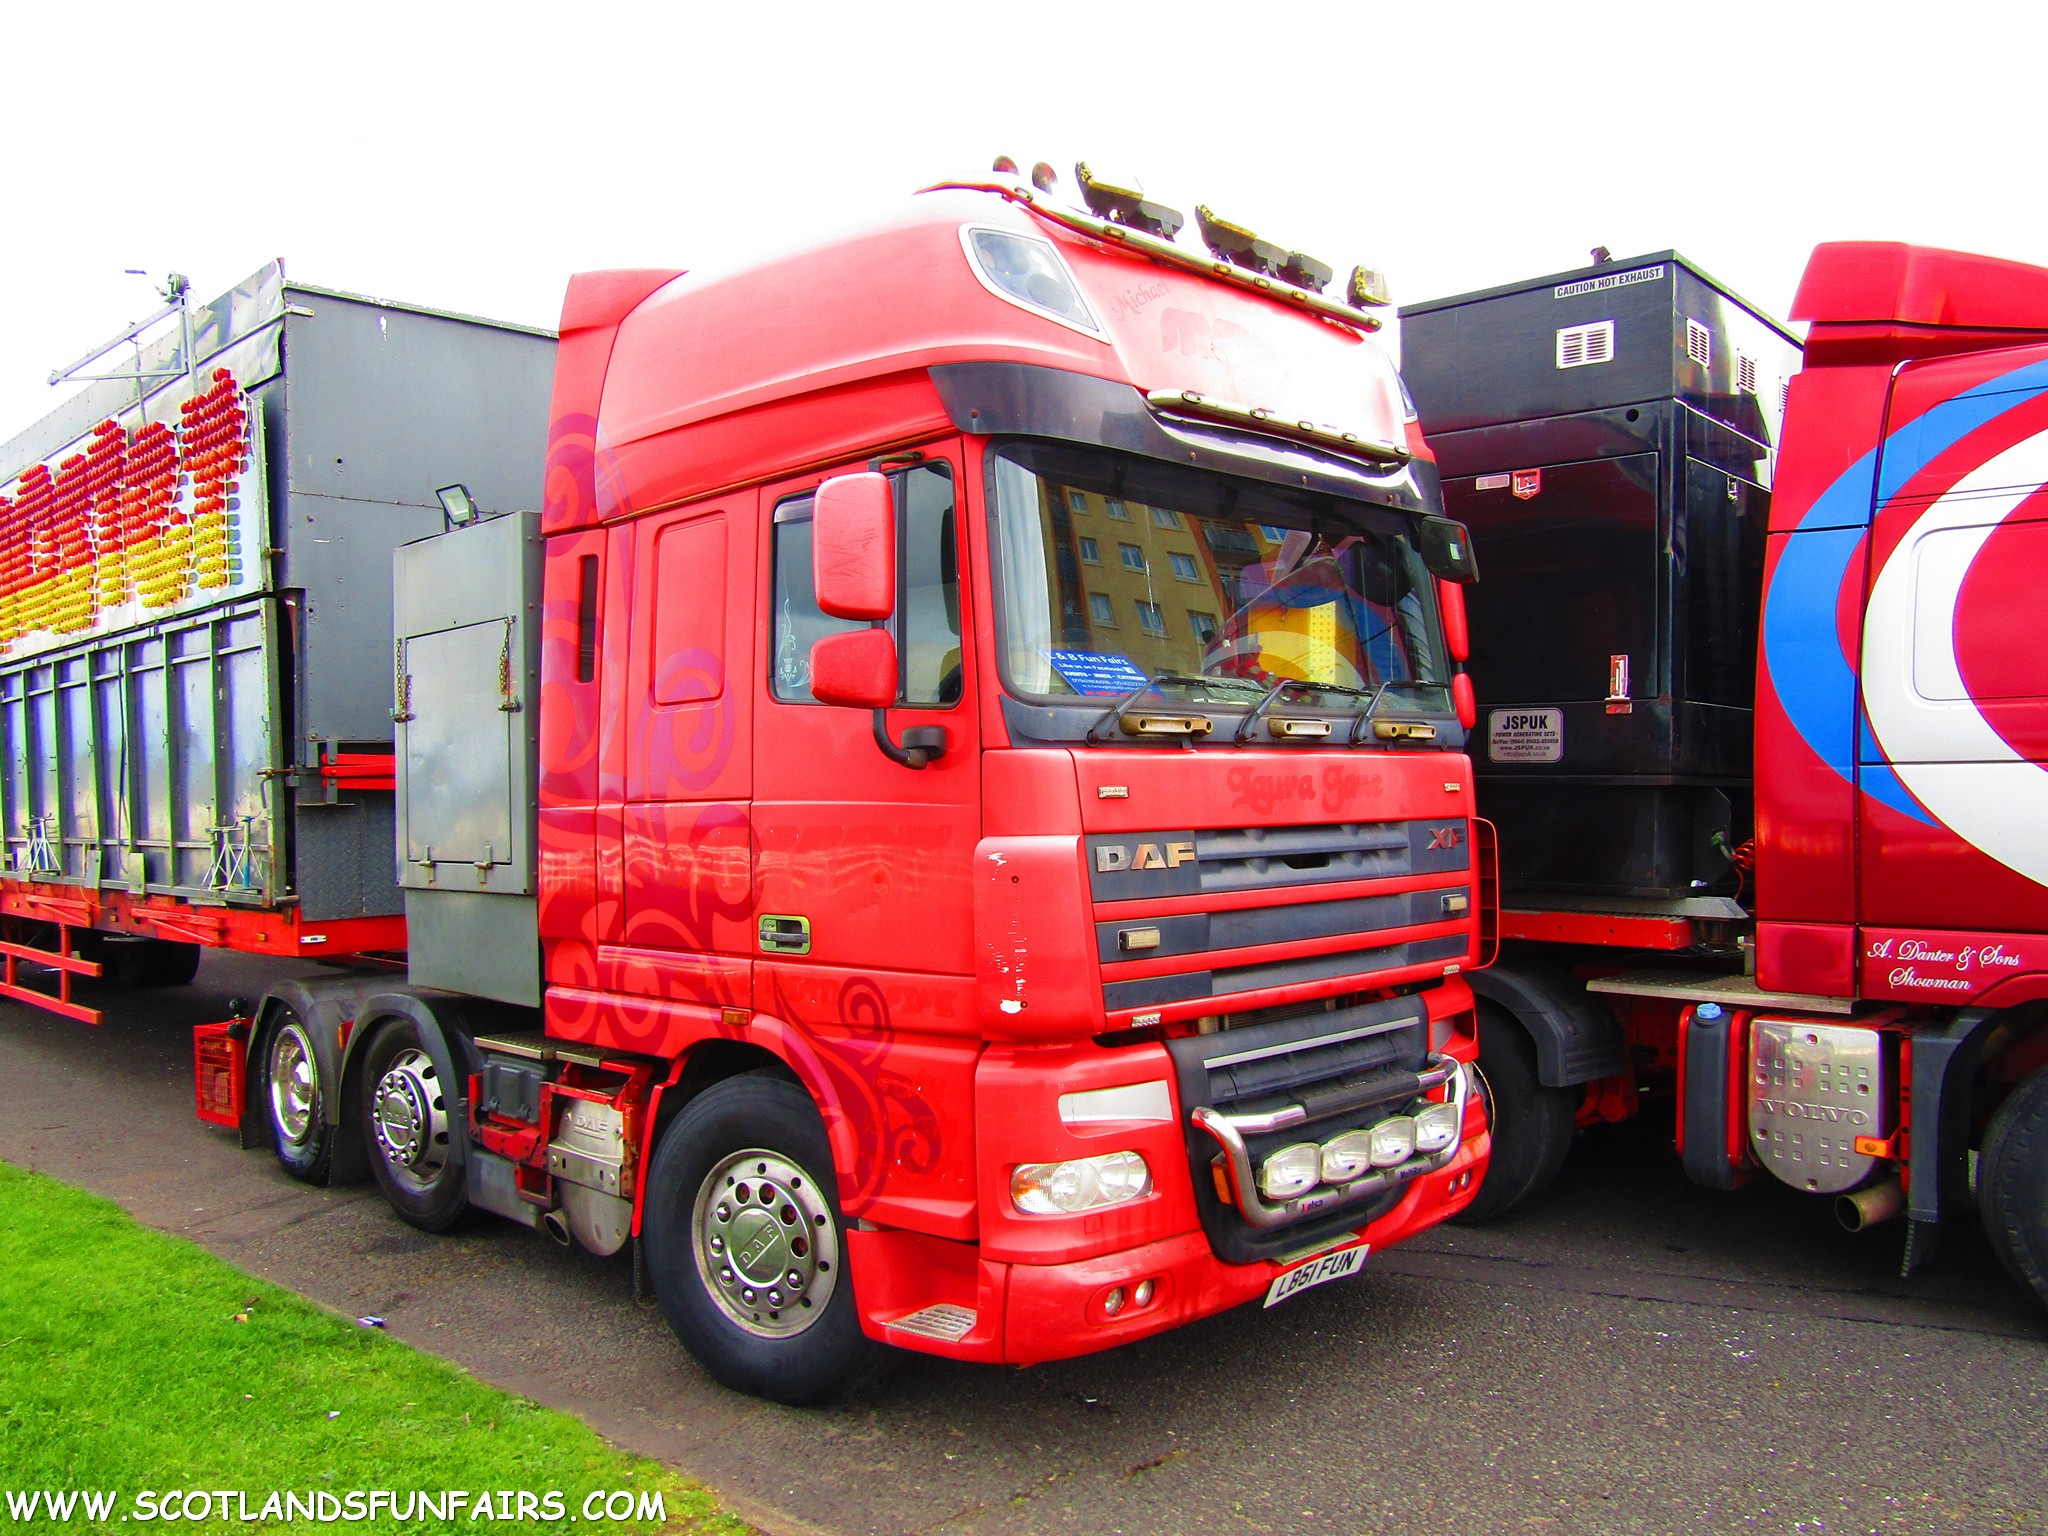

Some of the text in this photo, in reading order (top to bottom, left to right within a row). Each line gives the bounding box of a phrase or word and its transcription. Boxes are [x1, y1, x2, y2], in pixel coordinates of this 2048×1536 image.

[1557, 267, 1661, 297] CAUTION HOT EXHAUST
[1109, 279, 1170, 322] Michael
[1067, 653, 1078, 661] B
[1079, 654, 1101, 663] Fun
[1102, 656, 1129, 666] Fairs
[1503, 715, 1548, 729] JSPUK
[1226, 765, 1316, 816] Laura
[1427, 827, 1465, 850] XF
[1095, 841, 1195, 872] DAF
[1867, 938, 2020, 971] A. Danter & Sons
[1888, 966, 1971, 989] Showman
[575, 1115, 608, 1136] DAF
[1757, 1098, 1869, 1125] VOLVO
[739, 1224, 775, 1264] DAF
[1317, 1249, 1358, 1280] FUN
